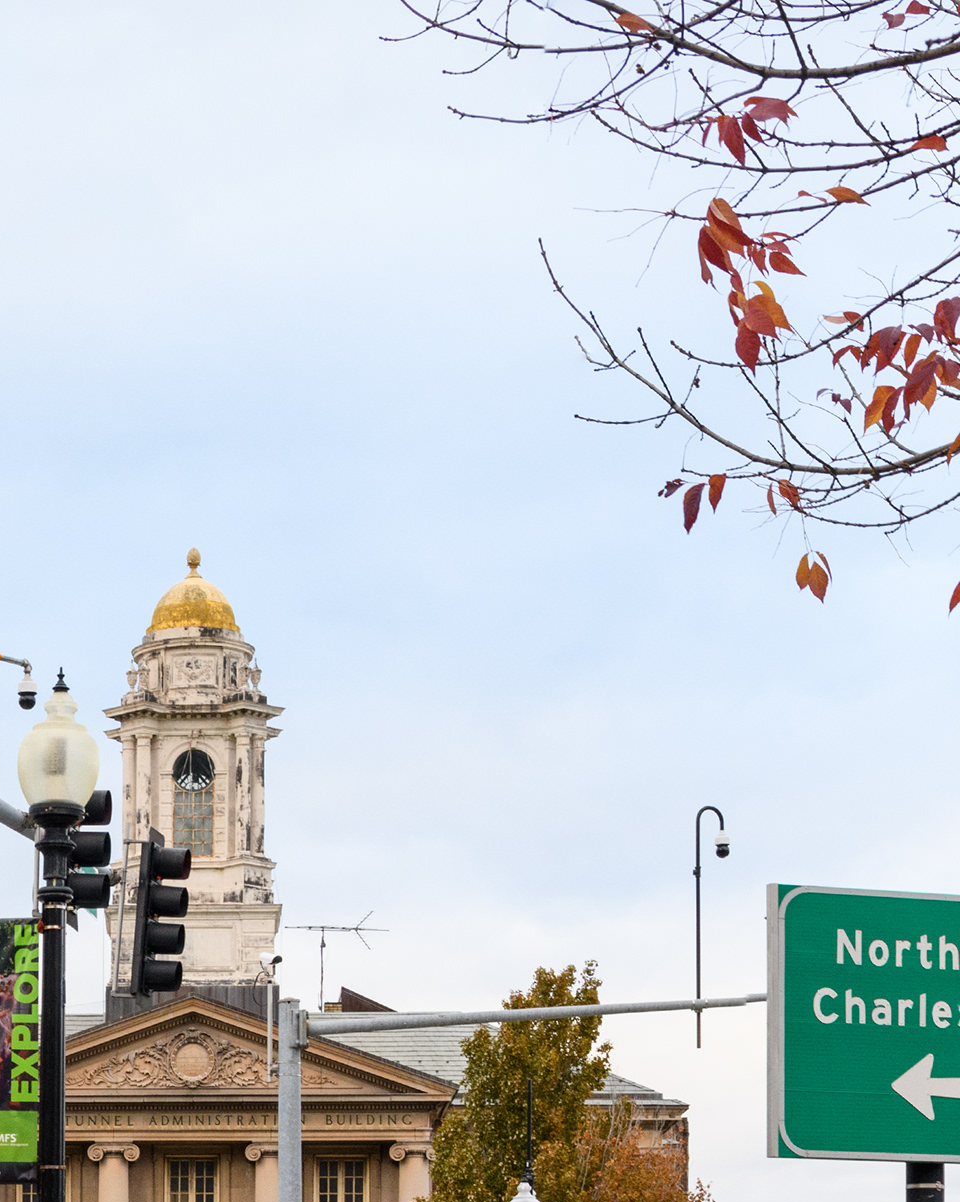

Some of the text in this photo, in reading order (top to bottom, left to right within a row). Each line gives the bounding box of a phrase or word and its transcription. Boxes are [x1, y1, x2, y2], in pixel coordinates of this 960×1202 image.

[836, 928, 960, 970] North
[10, 924, 39, 1102] EXPLORE
[813, 987, 960, 1029] Charle
[149, 1115, 306, 1126] ADMINISTRATIN
[325, 1114, 412, 1126] BUILDING
